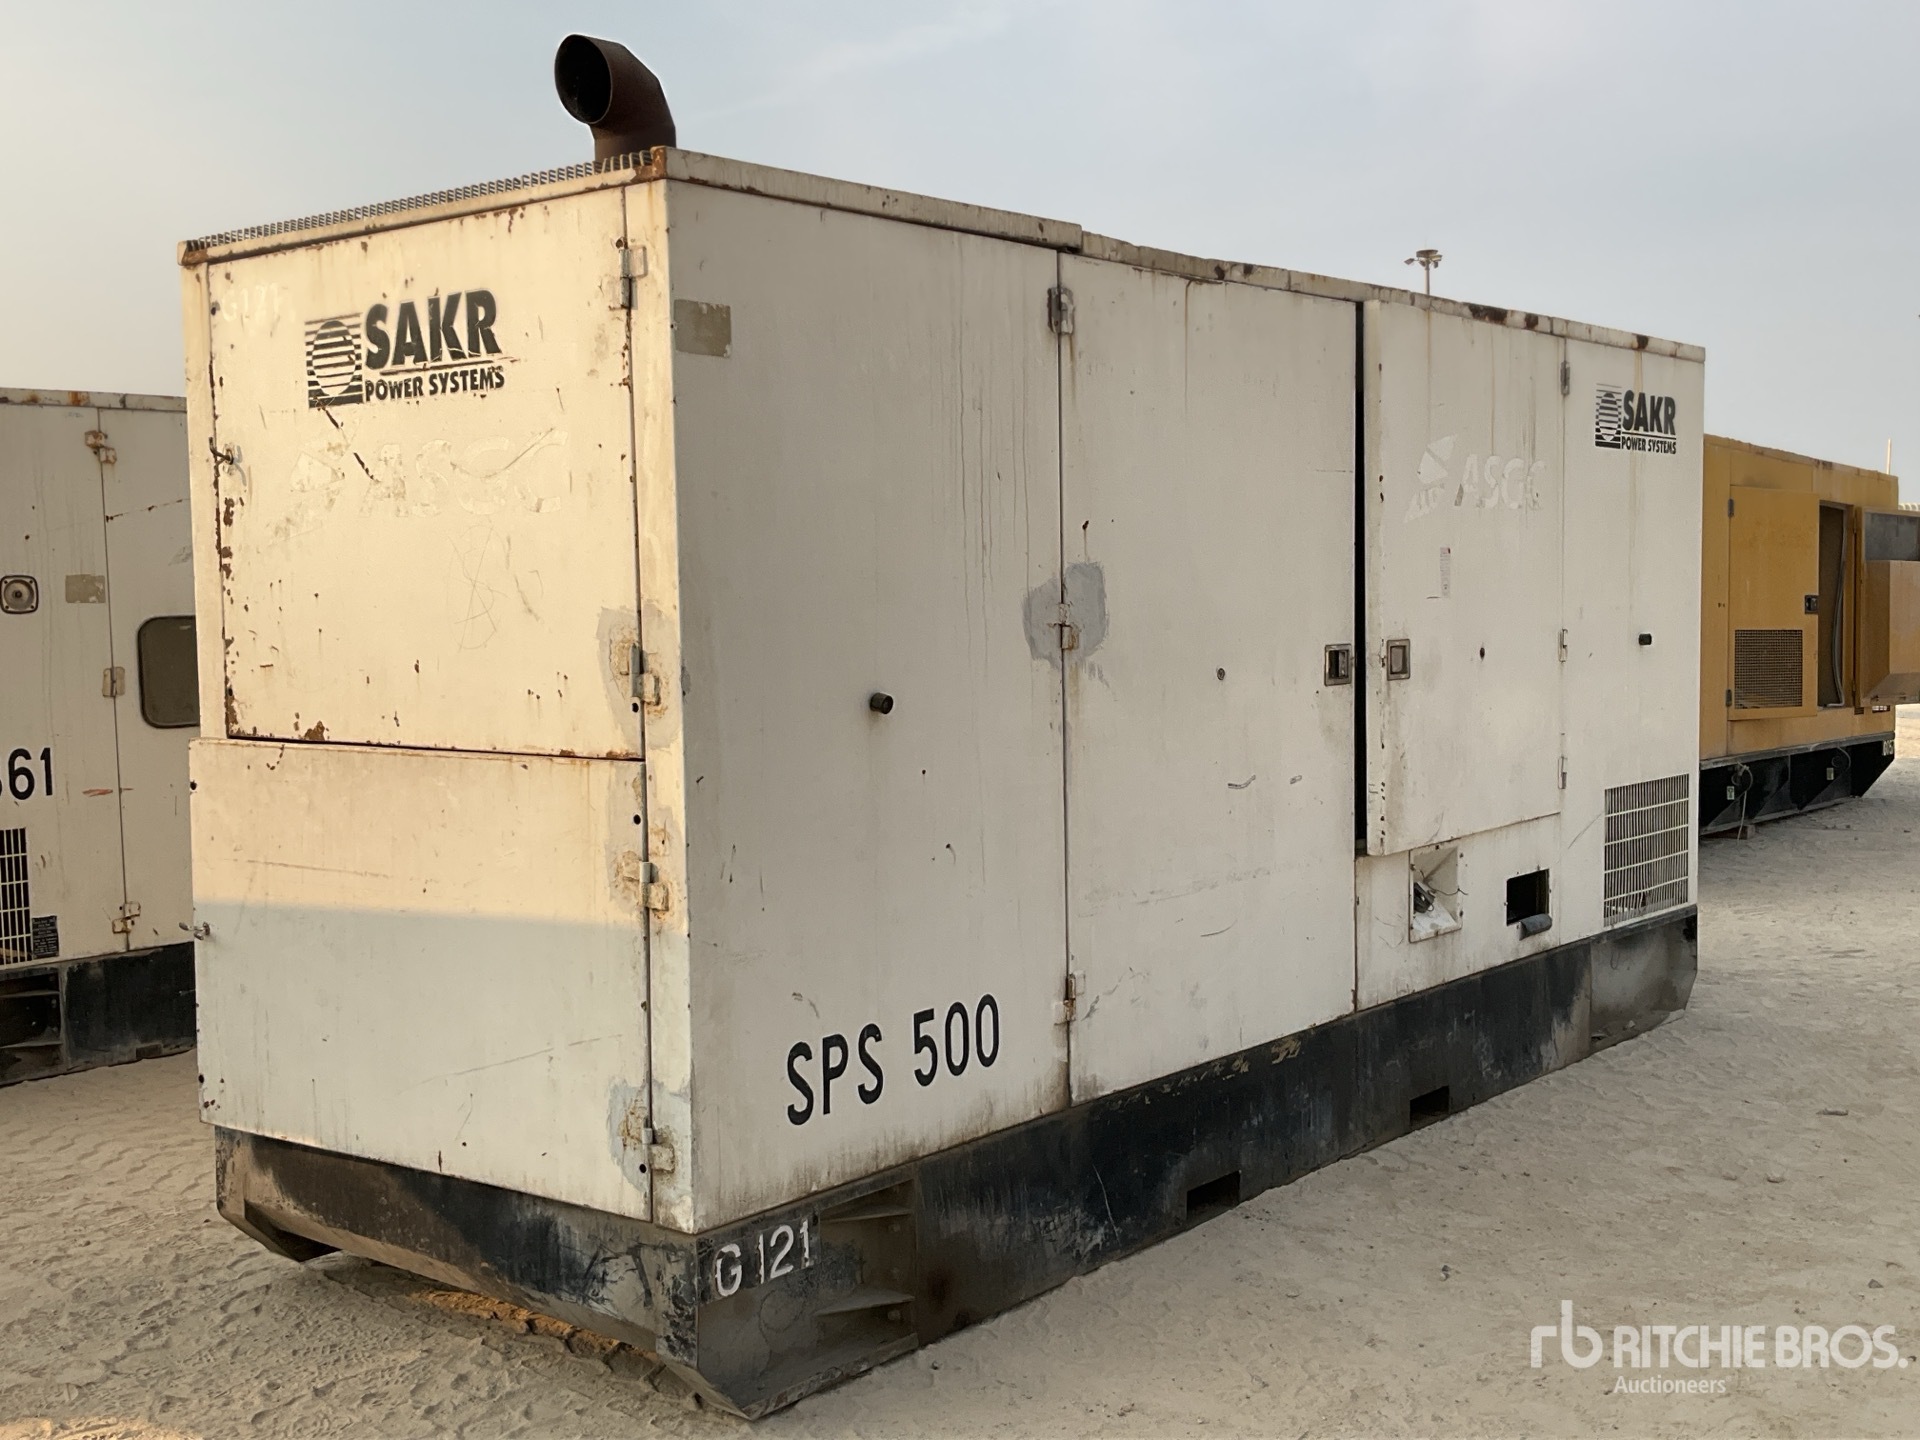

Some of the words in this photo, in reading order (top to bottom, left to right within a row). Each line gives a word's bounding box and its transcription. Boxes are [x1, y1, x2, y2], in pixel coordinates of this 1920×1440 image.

[365, 289, 502, 370] SAKR
[365, 375, 424, 402] POWER
[428, 366, 505, 396] SYSTEMS
[1622, 389, 1676, 436] SAKR
[1621, 436, 1647, 452] POWER
[1647, 438, 1677, 455] SYSTEMS
[0, 747, 53, 800] 61
[787, 1023, 884, 1126] SPS
[913, 993, 1000, 1087] 500
